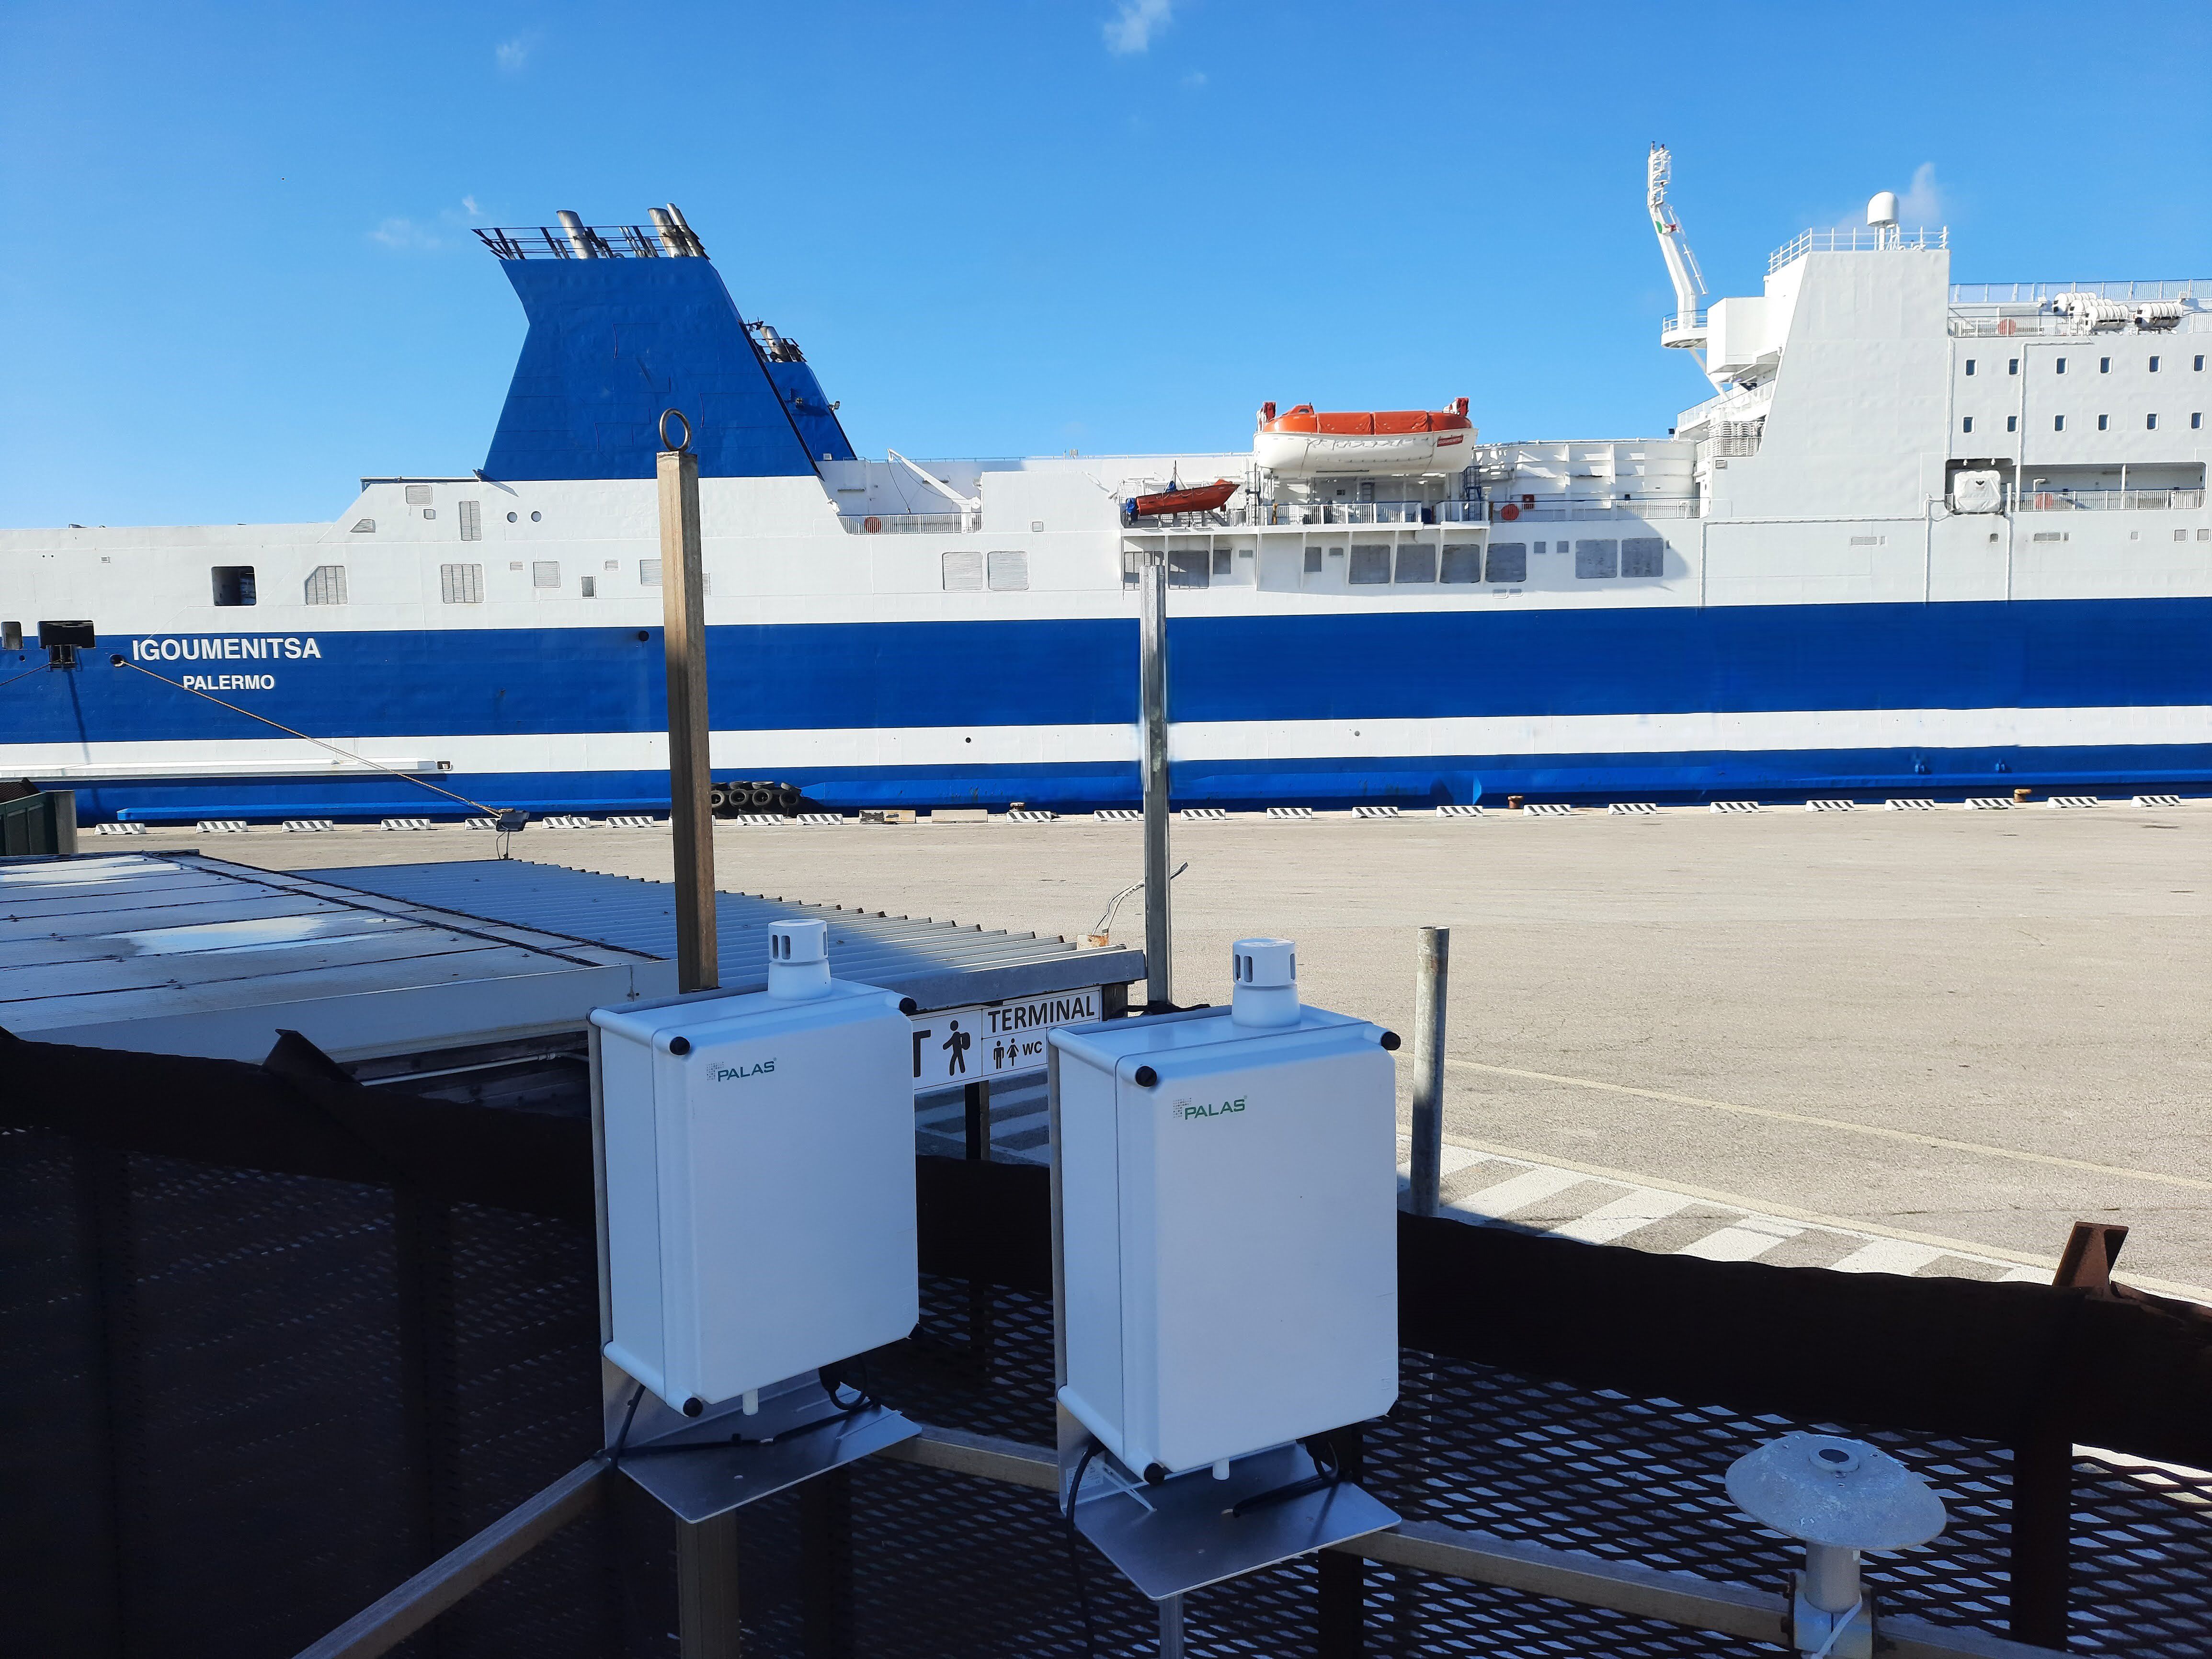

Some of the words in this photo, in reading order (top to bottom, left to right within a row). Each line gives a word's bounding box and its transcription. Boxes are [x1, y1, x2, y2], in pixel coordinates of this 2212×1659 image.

[132, 637, 321, 661] IGOUMENITSA
[183, 674, 274, 690] PALERMO
[988, 996, 1095, 1033] TERMINAL
[1022, 1041, 1042, 1056] WC
[718, 1060, 775, 1082] PALAS
[1185, 1099, 1245, 1120] PALAS
